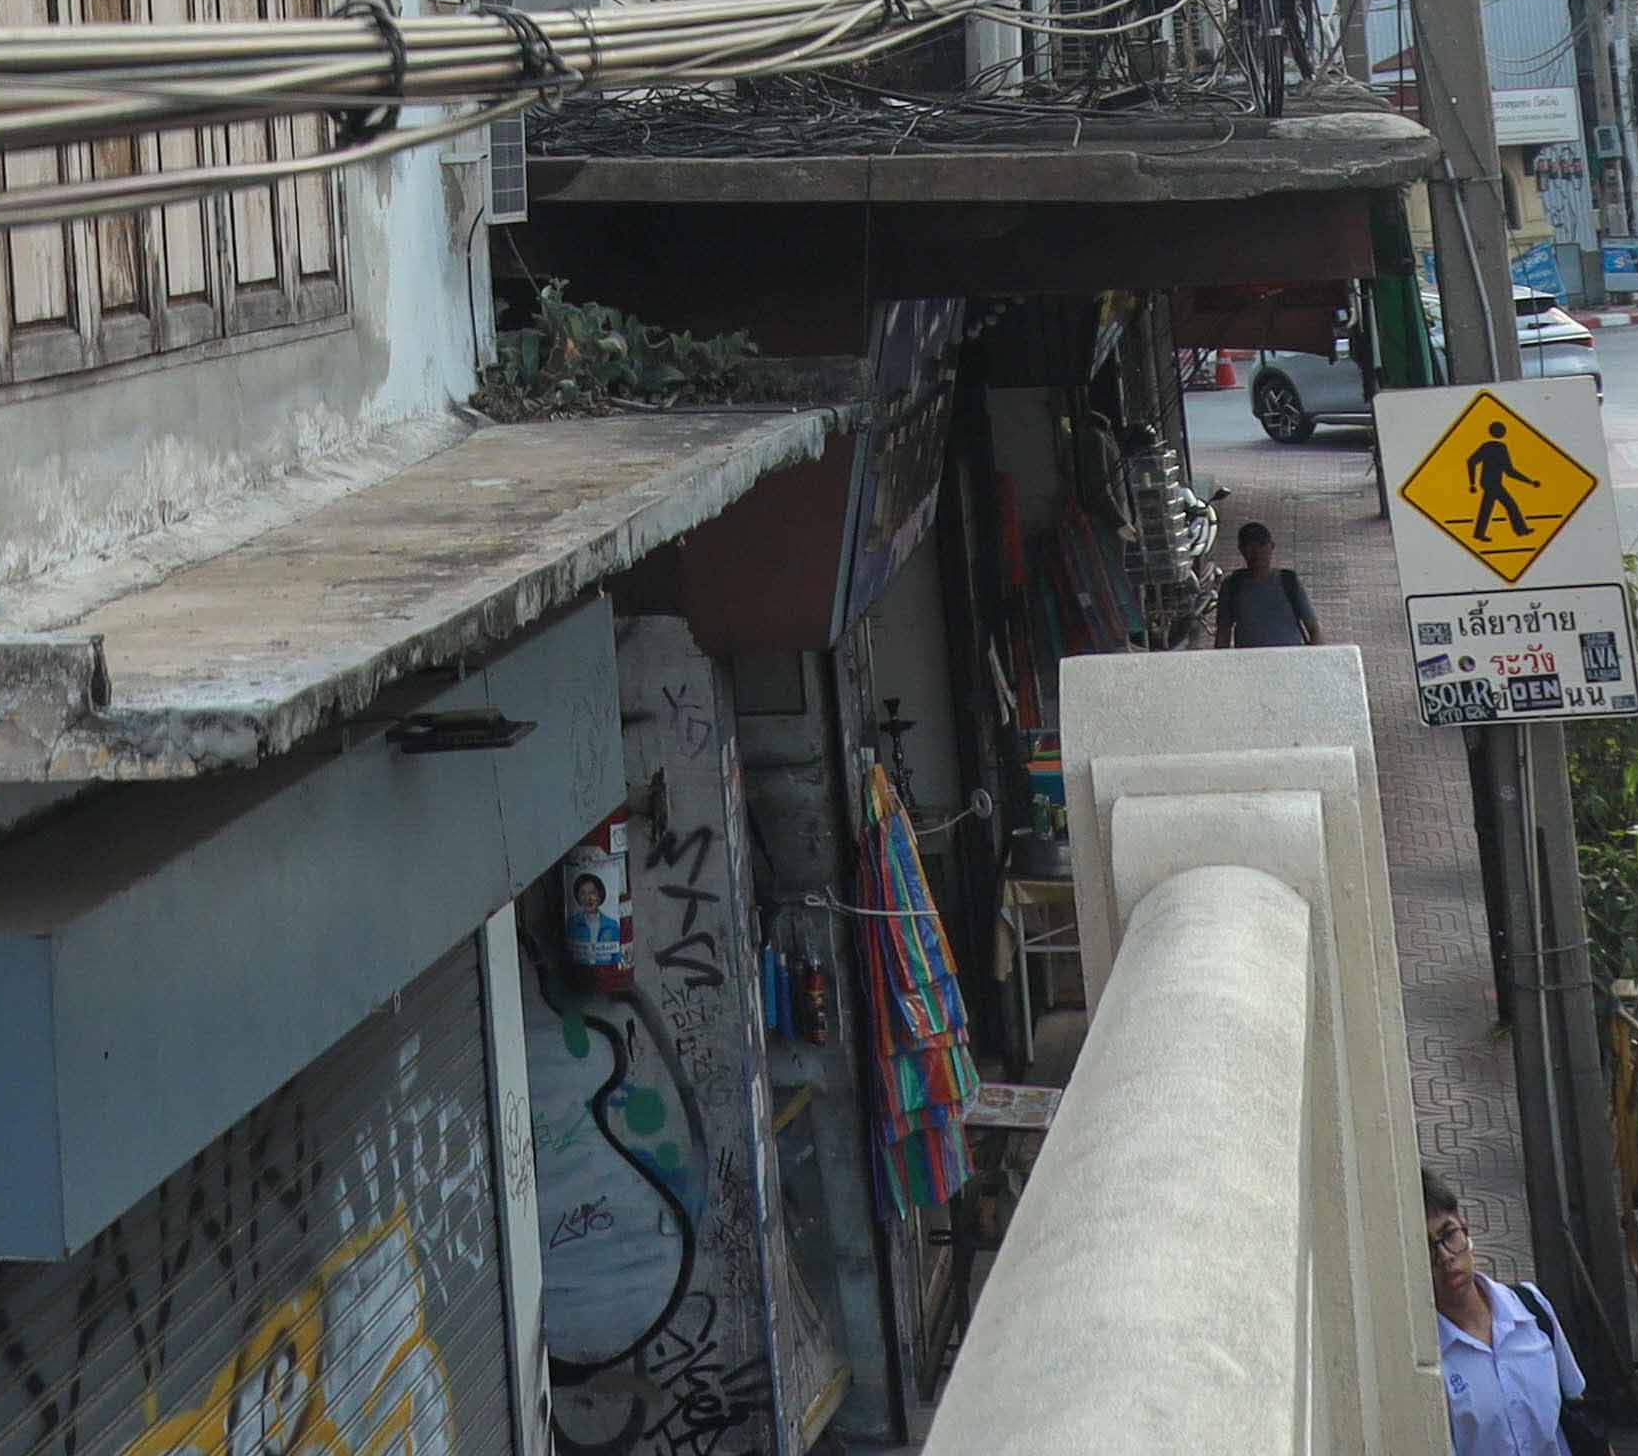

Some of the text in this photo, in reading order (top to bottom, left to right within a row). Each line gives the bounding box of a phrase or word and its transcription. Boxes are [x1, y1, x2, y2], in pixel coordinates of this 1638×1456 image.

[1457, 599, 1577, 636] เลี้ยวซ้าย
[1489, 643, 1557, 676] ระวัง
